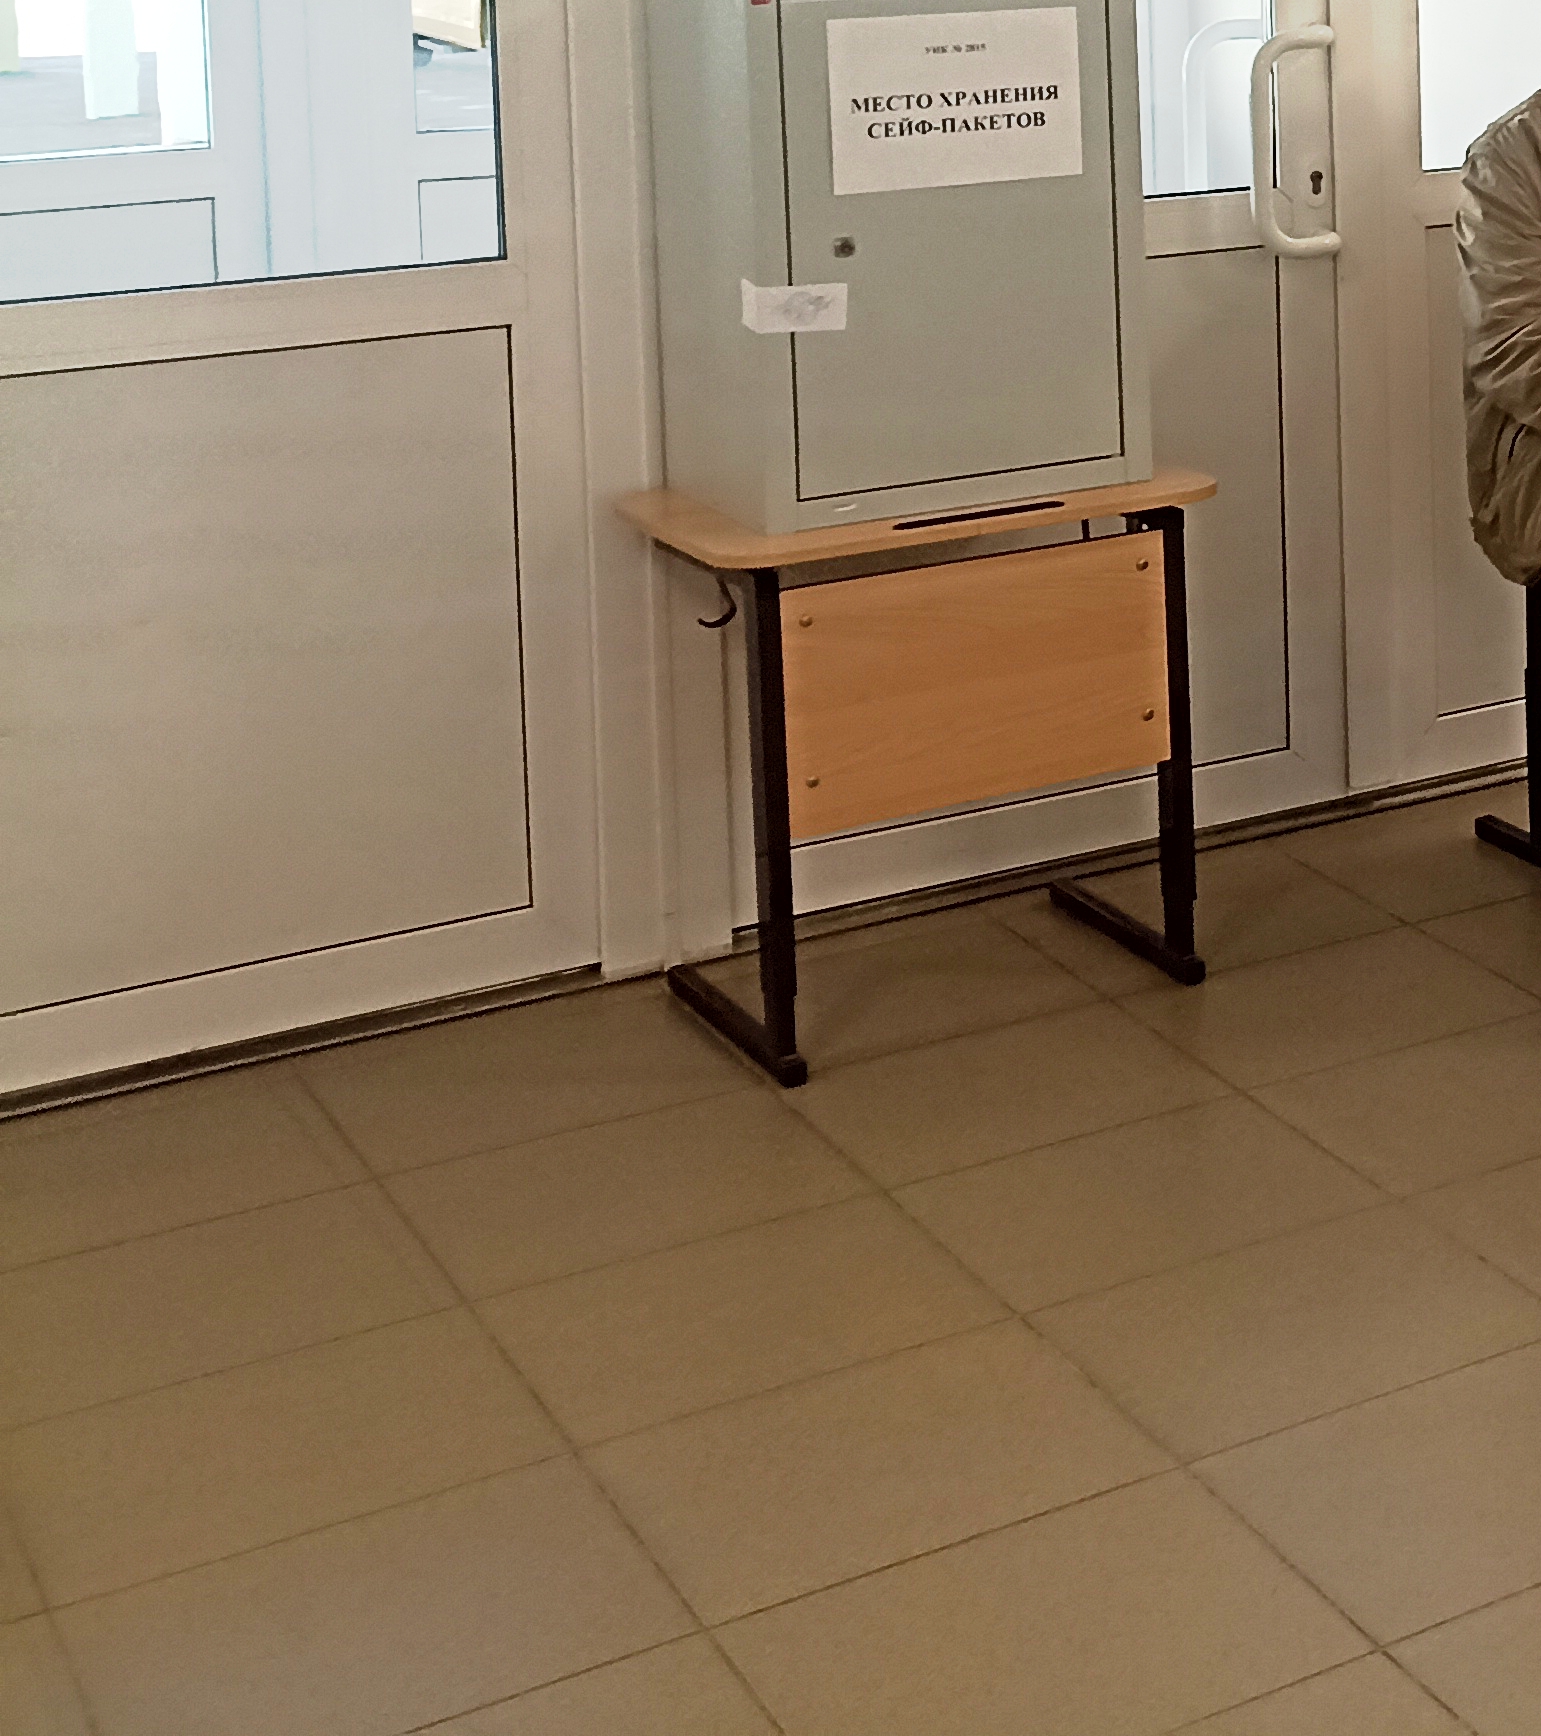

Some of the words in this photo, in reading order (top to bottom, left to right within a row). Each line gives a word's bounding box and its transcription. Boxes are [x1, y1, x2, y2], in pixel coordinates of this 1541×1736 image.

[851, 93, 933, 114] МЕСТО
[938, 84, 1059, 108] ХРАНЕНИЯ
[867, 111, 1046, 139] СЕЙФ-ПАКЕТОВ
